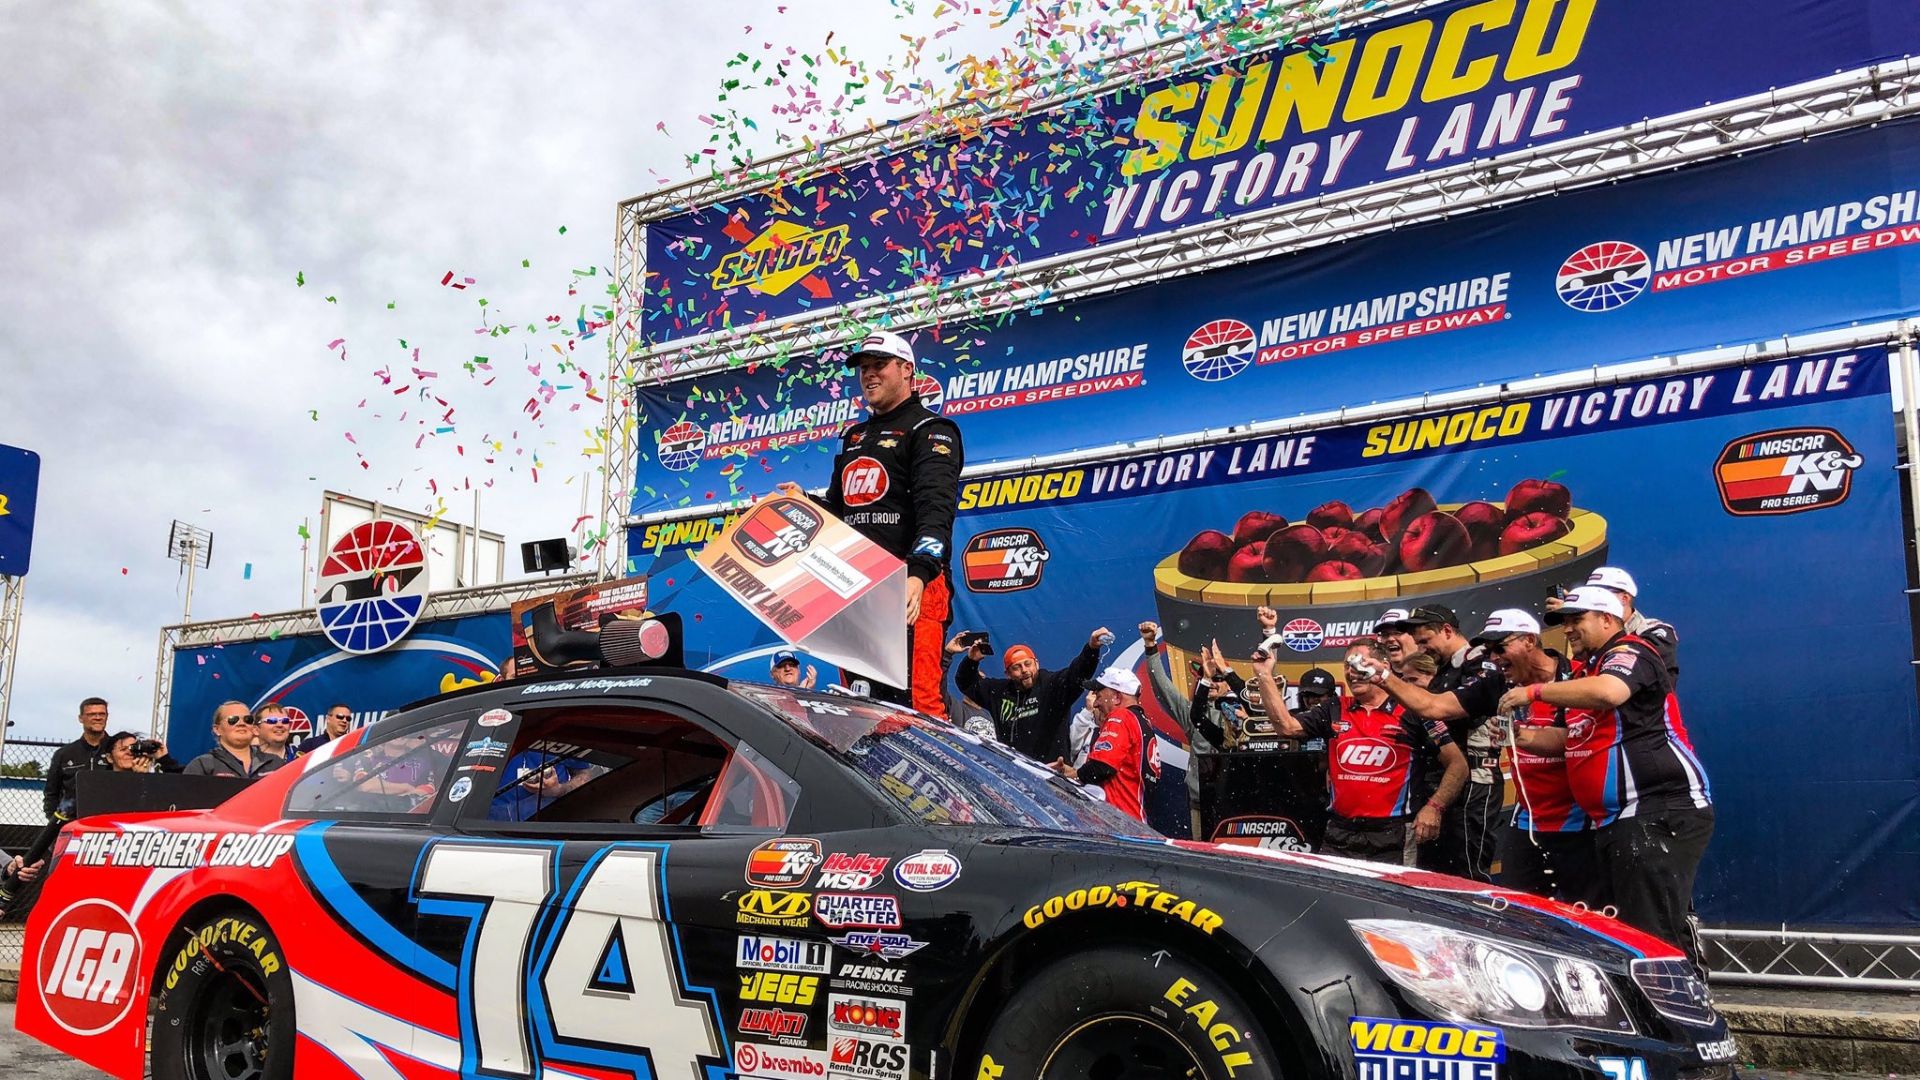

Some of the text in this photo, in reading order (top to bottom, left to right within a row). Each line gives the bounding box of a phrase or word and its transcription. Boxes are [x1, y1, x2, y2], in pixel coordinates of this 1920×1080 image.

[1121, 0, 1596, 176] SUNOCO
[1102, 74, 1583, 236] VICTORY LANE
[1654, 190, 1920, 271] NEW HAMPSH
[714, 229, 845, 286] SUNOCO
[1656, 257, 1769, 288] MOTOR
[1259, 272, 1511, 347] NEW HAMPSHIRE
[1260, 307, 1501, 362] MOTOR SPEEDWAY
[946, 343, 1148, 400] NEW HAMPSHIRE
[946, 374, 1141, 414] MOTOR SPEEDWAY
[1361, 355, 1857, 457] SUNOCO VICTORY LANE
[706, 396, 863, 446] NEW HAMPSHIRE
[706, 441, 761, 458] MOTOR
[1759, 434, 1825, 456] NASCAR
[843, 467, 881, 497] IGA
[958, 436, 1316, 510] SUNOCO VICTORY LANE
[1760, 494, 1819, 509] PRO SERIES
[786, 508, 817, 530] NASCAR
[872, 512, 901, 525] GROUP
[913, 536, 944, 557] 74
[990, 533, 1029, 548] NASCAR
[612, 582, 646, 596] ULTIMATE
[710, 552, 804, 630] VICTORY LANE
[988, 578, 1023, 588] PRO SERIES
[586, 596, 611, 608] POWER
[1324, 622, 1361, 637] NEW
[521, 678, 653, 695] Brandon McReynolds
[1340, 745, 1390, 767] IGA
[1241, 822, 1287, 835] NASCAR
[75, 832, 295, 868] THE REICHERT GROUP
[778, 843, 813, 851] NASCAR
[820, 852, 890, 877] Holley
[903, 863, 952, 875] TOTAL SEAL
[815, 872, 873, 890] MSD
[817, 895, 894, 914] QUARTER
[829, 909, 897, 925] MASTER
[1023, 881, 1224, 935] GOODYEAR
[736, 912, 809, 928] MECHANIX WEAR
[165, 918, 280, 990] GOODYEAR
[742, 938, 800, 964] Mobil
[847, 935, 909, 948] FIVE STAR
[45, 927, 135, 1005] IGA
[416, 842, 723, 1080] 74
[793, 964, 825, 972] LUBRICANTS
[838, 964, 907, 983] PENSKE
[739, 972, 819, 1006] JEGS
[845, 981, 899, 994] RACING SHOCKS
[740, 1009, 805, 1034] LUNATI
[833, 999, 901, 1030] KOOKS
[779, 1038, 808, 1047] CRANKS
[1350, 1021, 1497, 1059] MOOG
[761, 1051, 824, 1076] brembo
[854, 1039, 906, 1071] RCS
[856, 1067, 874, 1076] Coil
[875, 1069, 902, 1080] Spring
